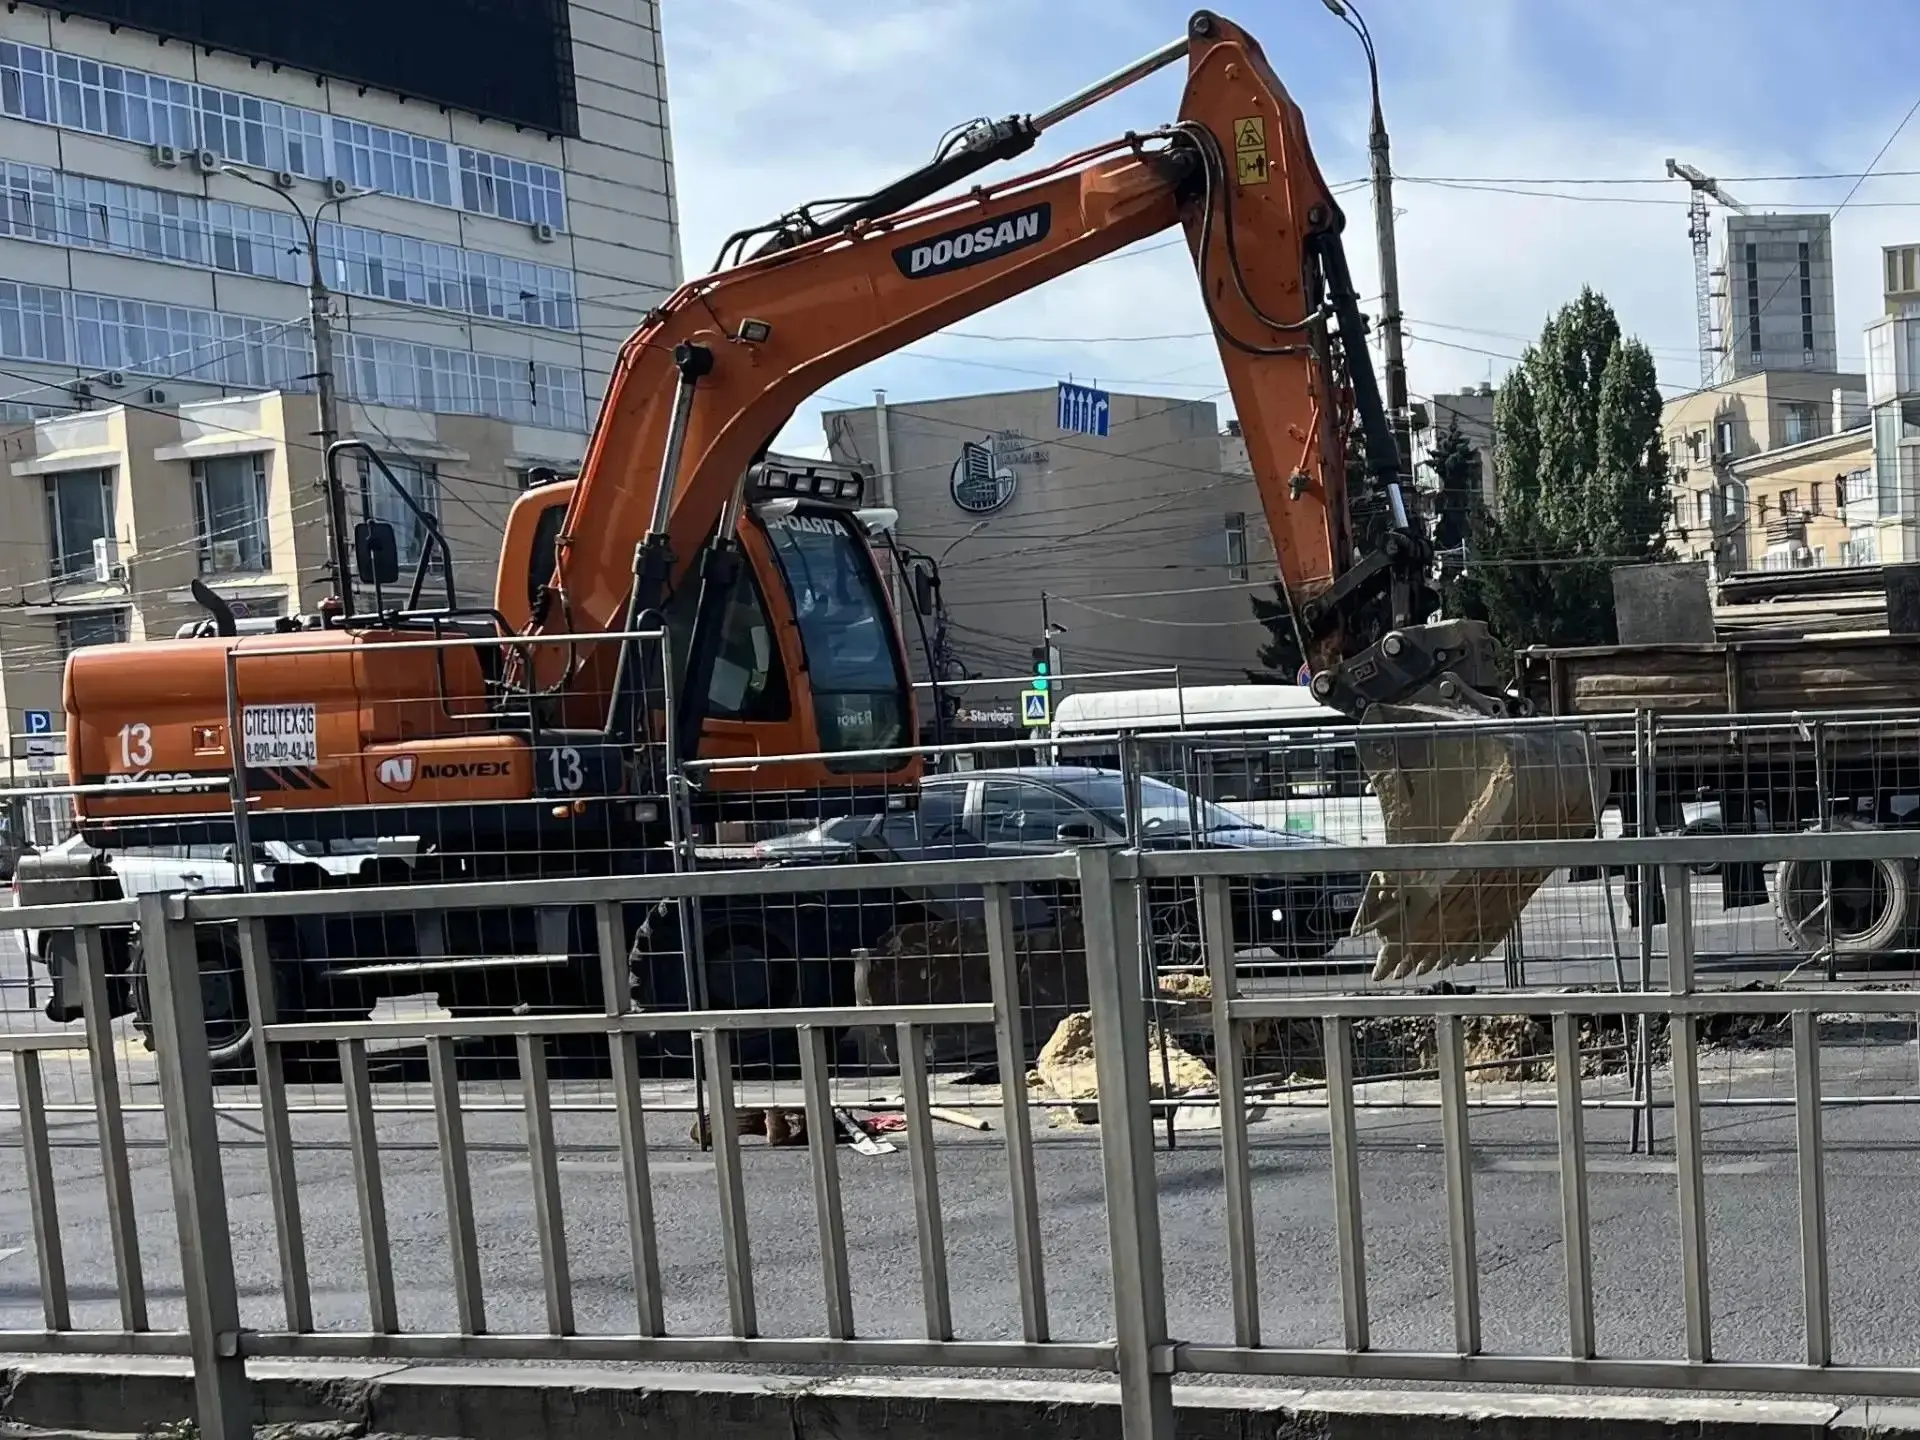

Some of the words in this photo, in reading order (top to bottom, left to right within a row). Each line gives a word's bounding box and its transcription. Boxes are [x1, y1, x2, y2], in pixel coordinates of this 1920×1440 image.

[911, 212, 1039, 273] DOOSAN
[31, 713, 47, 733] P
[245, 708, 314, 739] СПЕЦТЕХ36
[969, 709, 1014, 725] Stardogs
[118, 722, 153, 768] 13
[421, 761, 511, 779] NOVEX
[549, 747, 584, 791] 13
